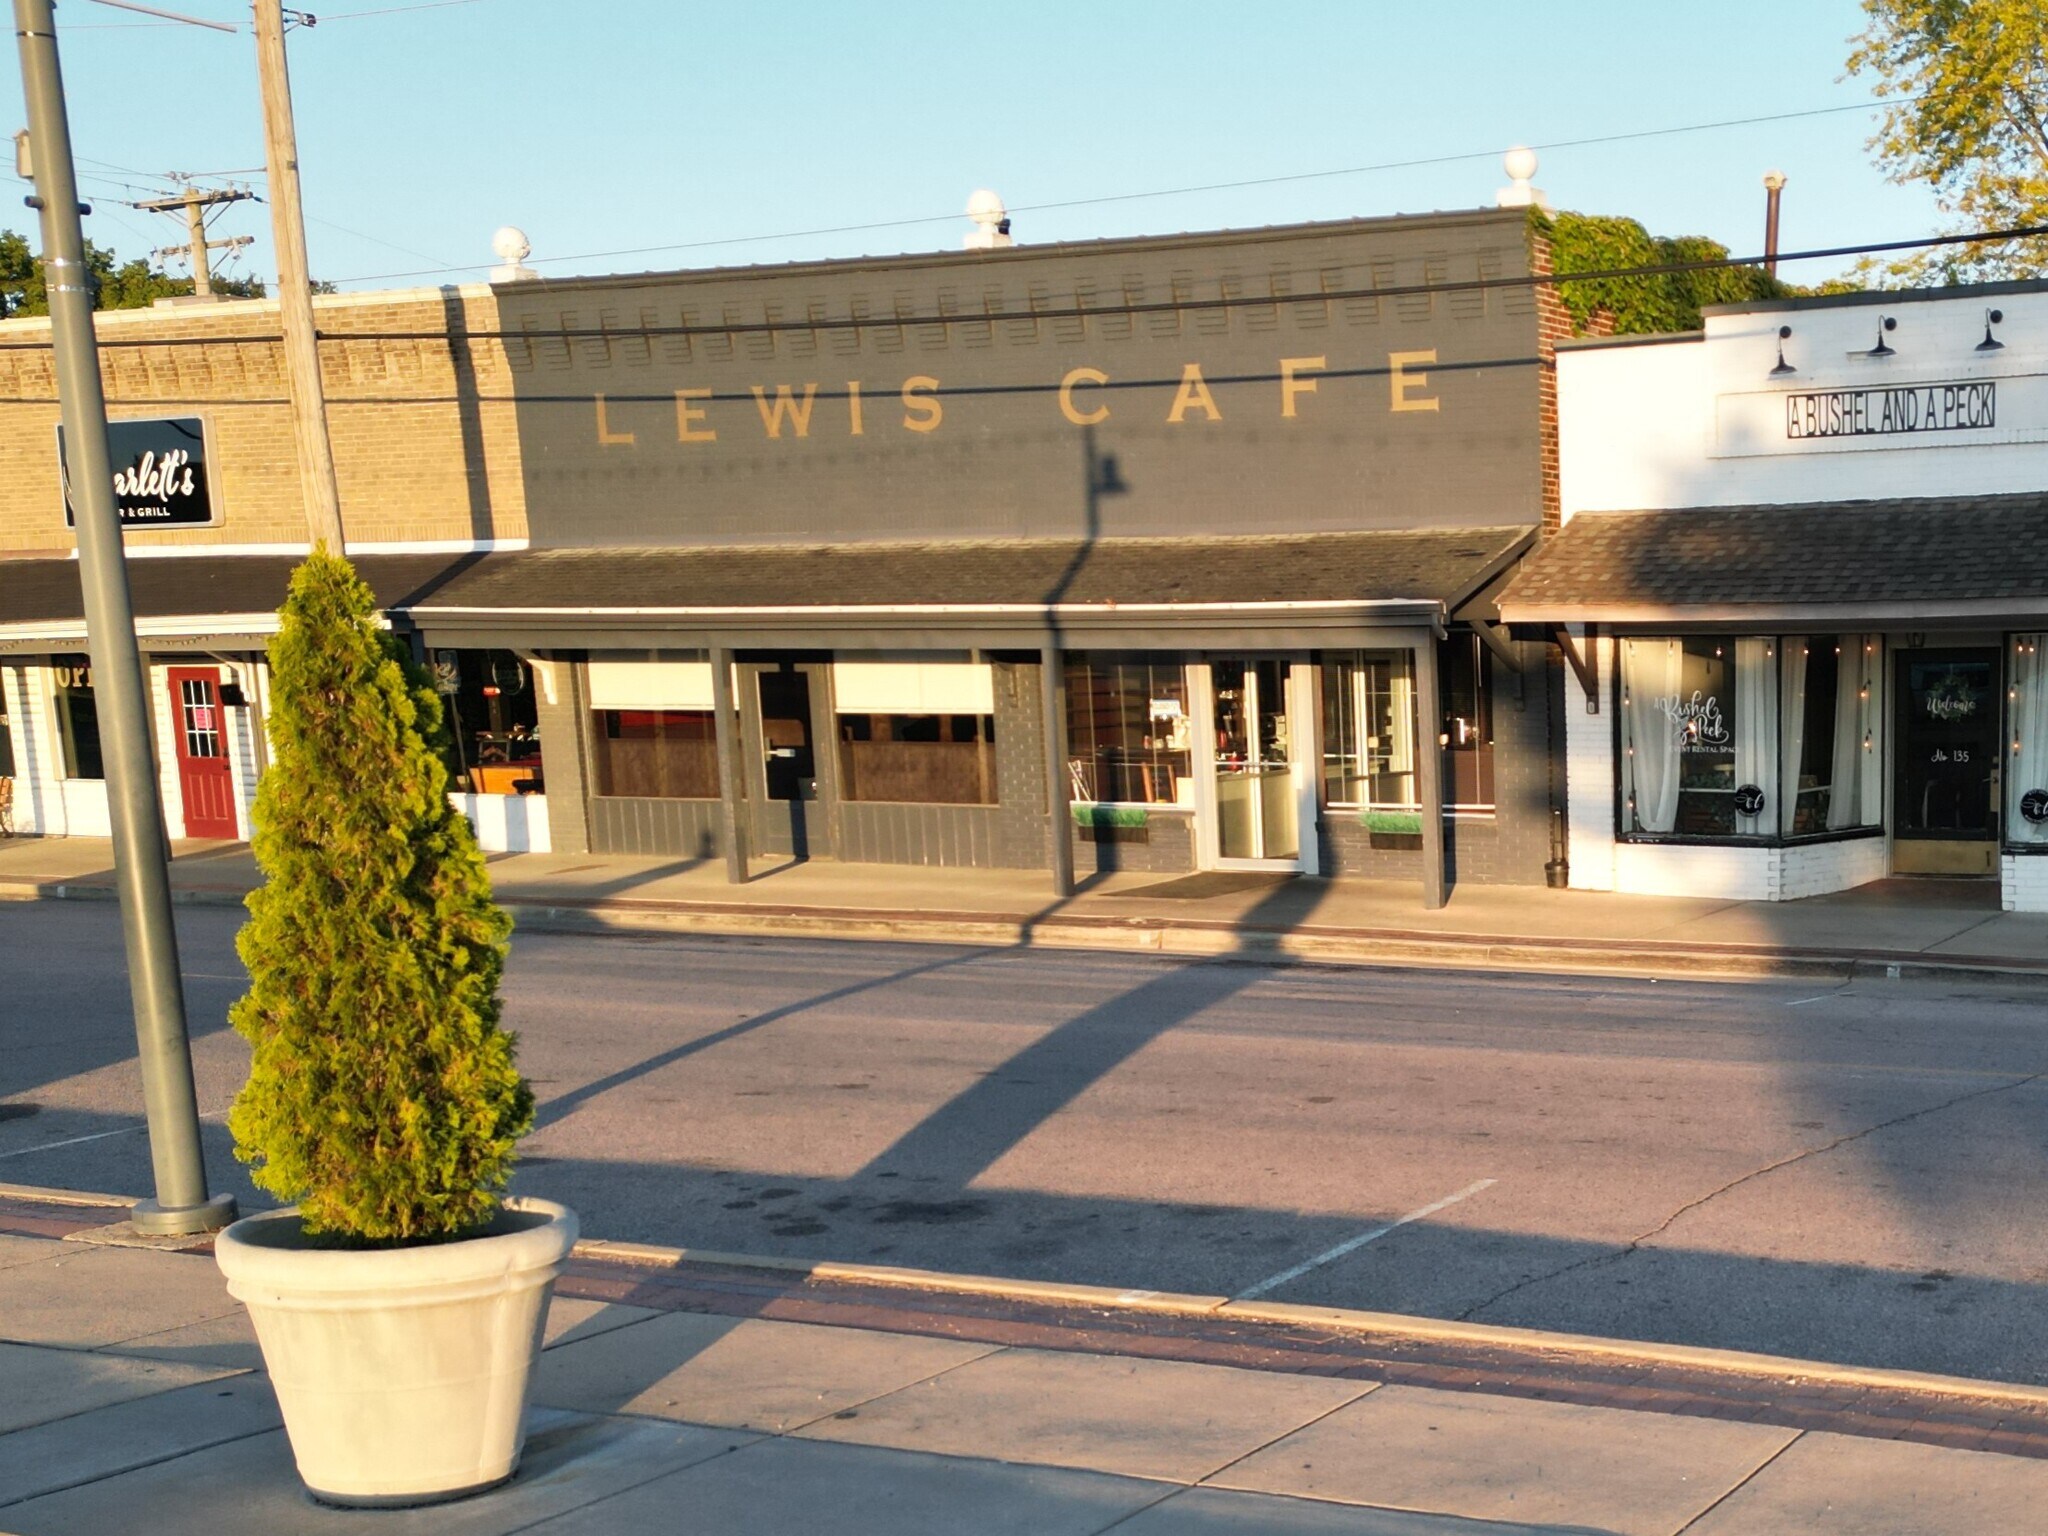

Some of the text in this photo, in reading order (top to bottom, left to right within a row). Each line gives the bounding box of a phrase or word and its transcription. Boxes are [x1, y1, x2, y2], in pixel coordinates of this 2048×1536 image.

[594, 348, 1440, 445] LEWIS CAFE
[1789, 384, 1994, 437] A BUSHEL AND A PECK
[137, 507, 171, 517] GRILL
[1953, 749, 1970, 763] 135
